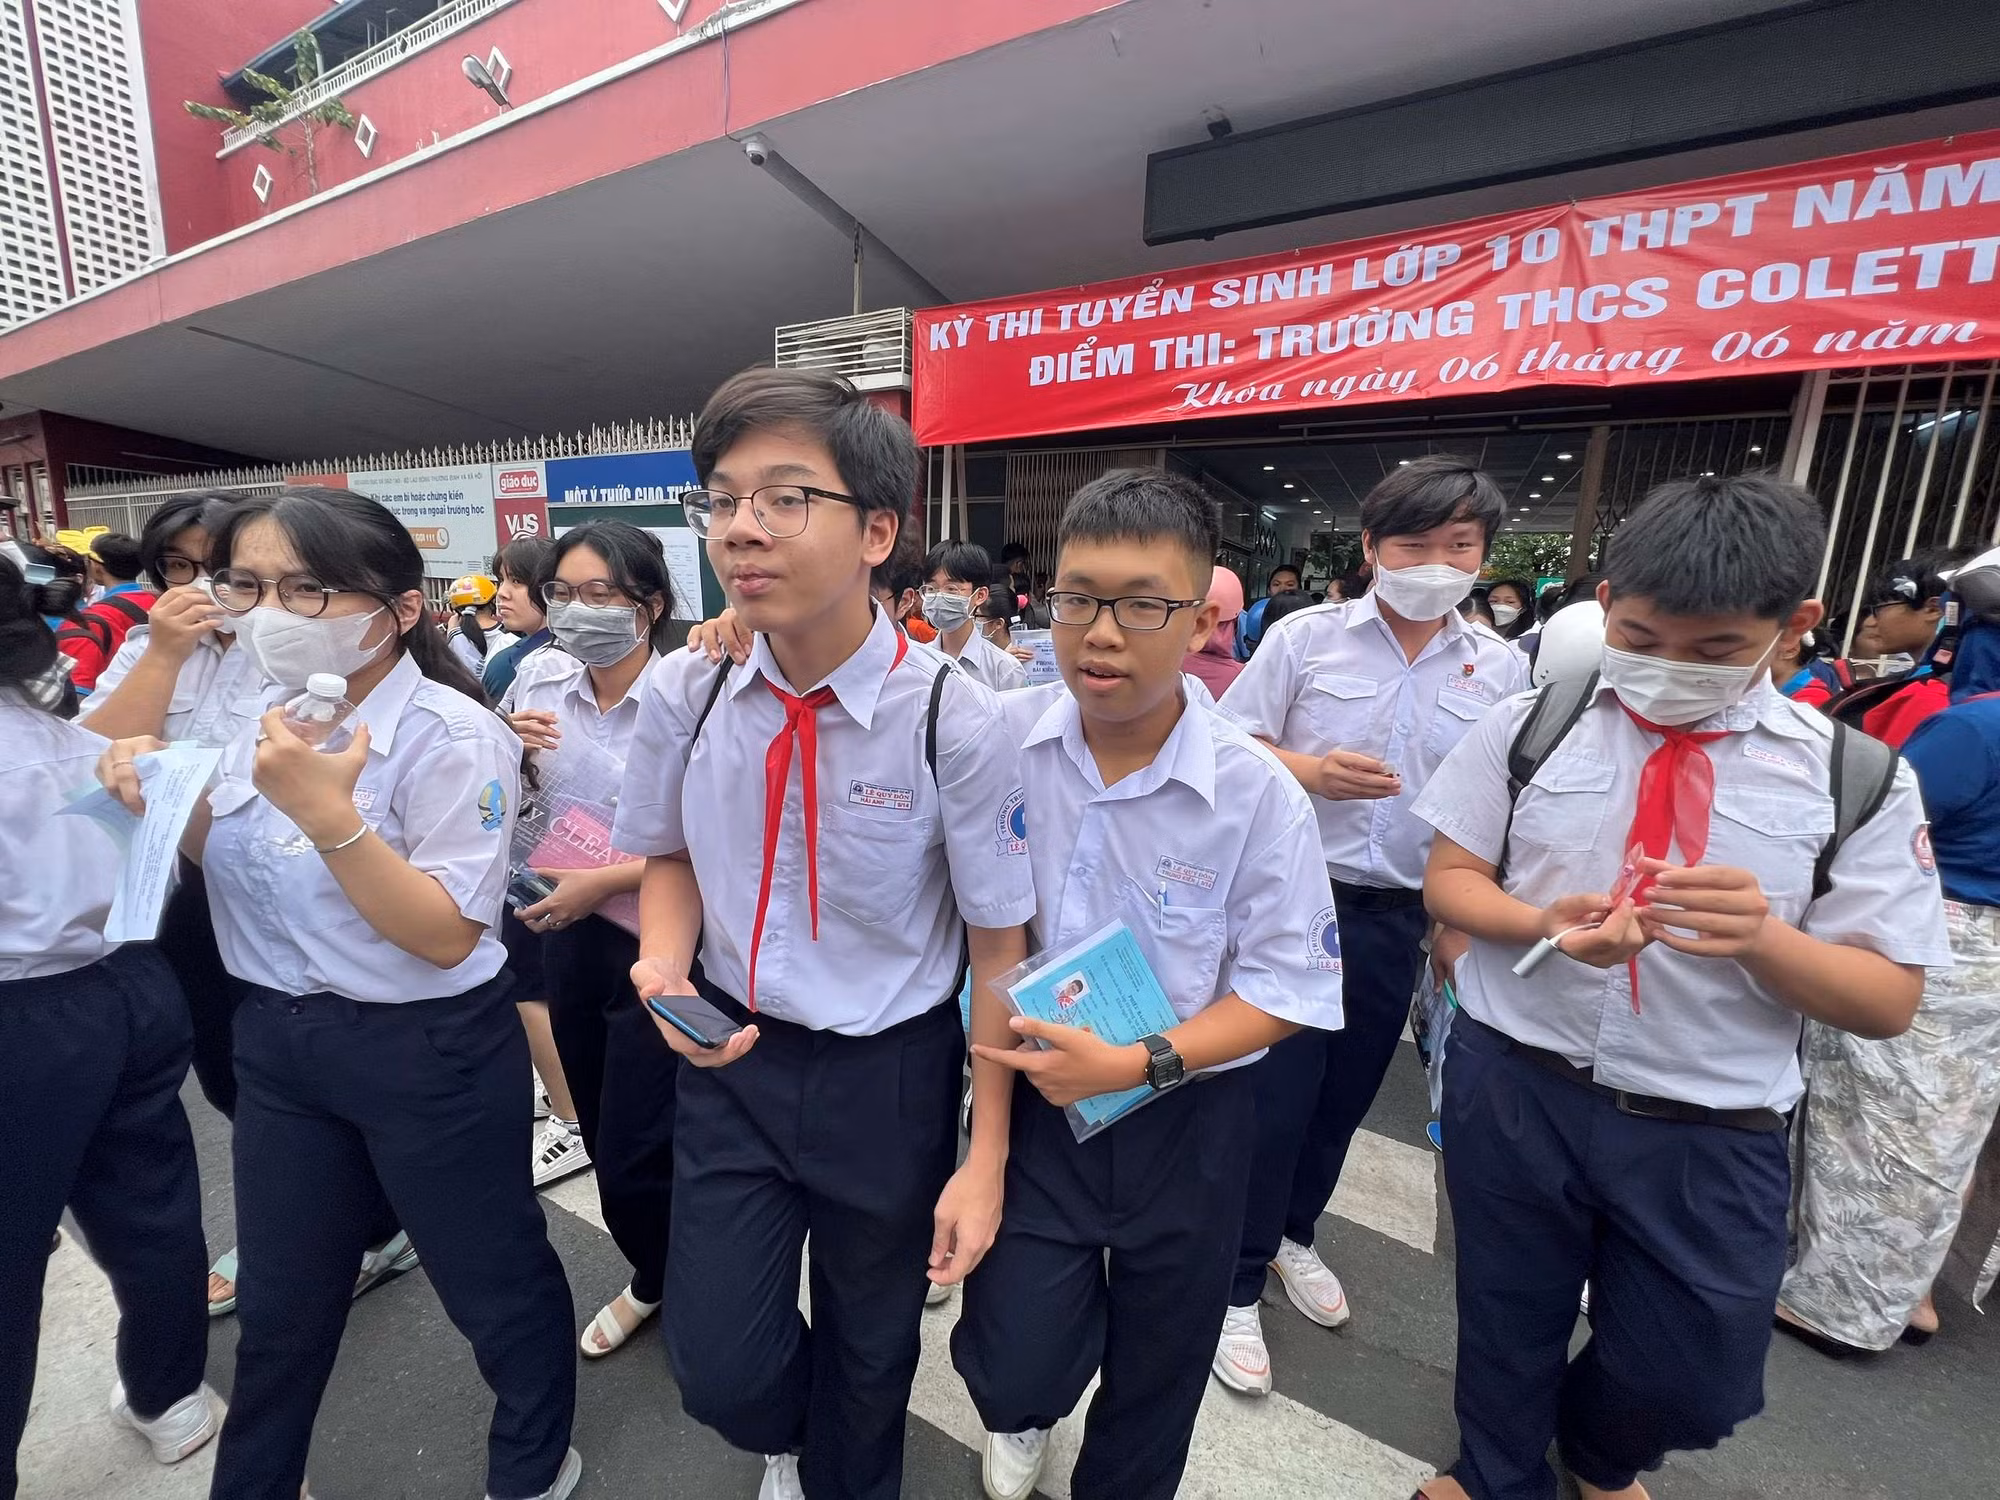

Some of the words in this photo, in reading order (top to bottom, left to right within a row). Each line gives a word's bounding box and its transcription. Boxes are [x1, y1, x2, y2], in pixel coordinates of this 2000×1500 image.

[929, 314, 974, 352] KỲ
[985, 310, 1042, 342] THI
[1057, 278, 1194, 330] TUYỂN
[1210, 265, 1334, 309] SINH
[1352, 243, 1462, 291] LỚP
[1486, 228, 1560, 271] 10
[1584, 193, 1768, 257] THPT
[1792, 158, 2000, 228] NĂM
[1029, 336, 1135, 387] ĐIỂM
[1151, 332, 1235, 370] THI:
[1253, 298, 1474, 361] TRƯỜNG
[1498, 277, 1668, 331] THCS
[1697, 236, 2000, 310] COLETT
[1167, 374, 1286, 412] Khóa
[1300, 366, 1420, 401] ngày
[1438, 352, 1499, 383] 06
[1518, 341, 1686, 376] tháng
[1711, 325, 1792, 363] 06
[1813, 320, 1984, 355] năm
[501, 474, 520, 491] giáo
[521, 474, 538, 489] dục
[504, 513, 539, 536] VUS
